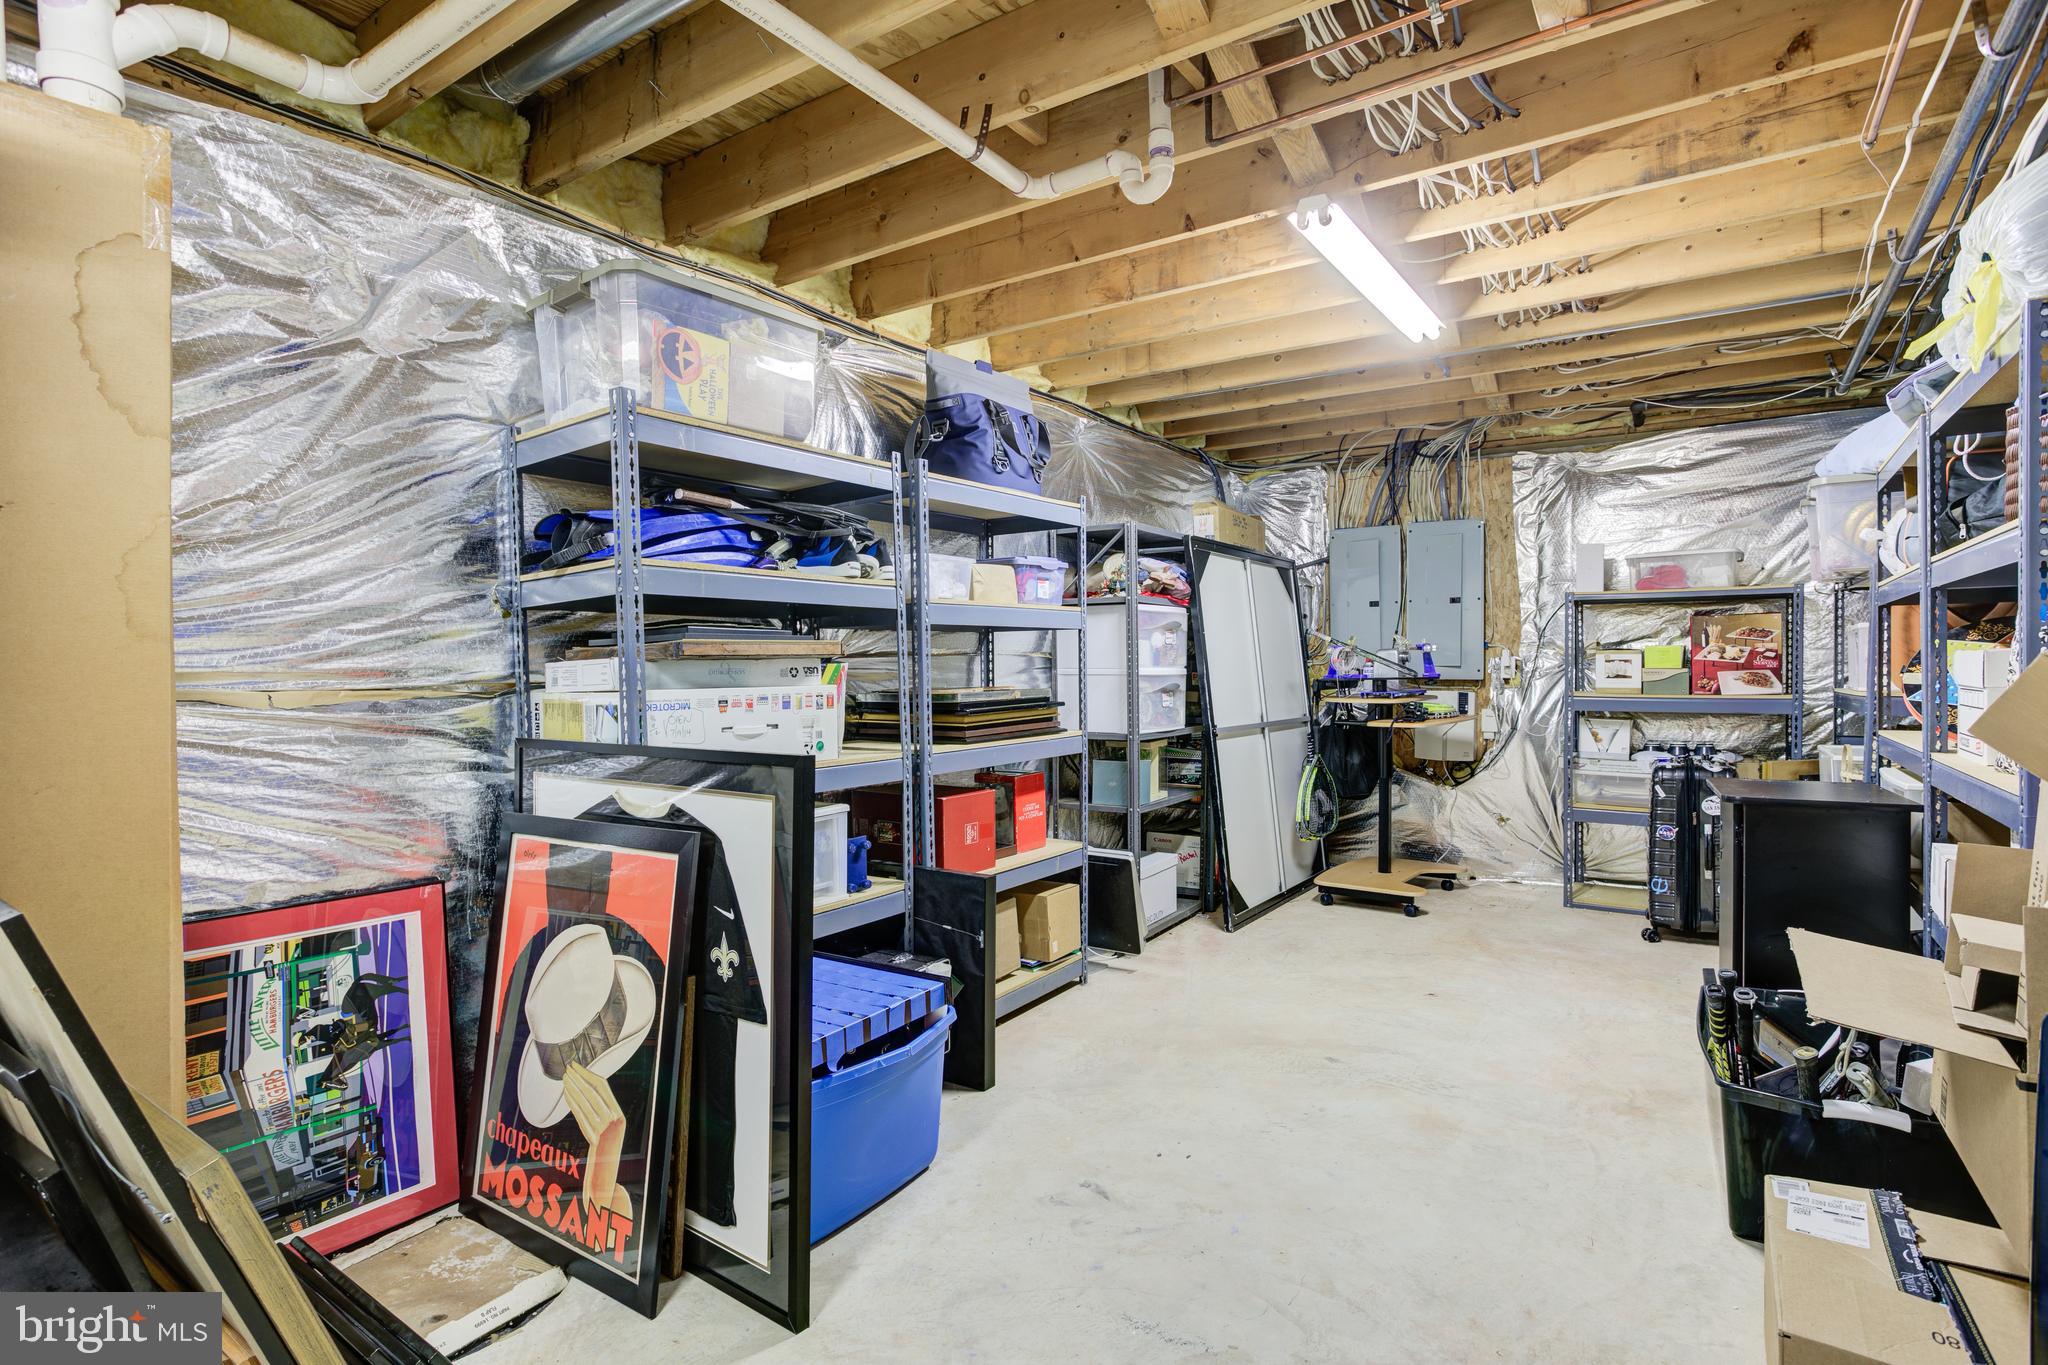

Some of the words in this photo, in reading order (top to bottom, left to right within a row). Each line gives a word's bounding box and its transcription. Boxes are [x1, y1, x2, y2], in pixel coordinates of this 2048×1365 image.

[698, 379, 709, 401] PLAY
[708, 368, 717, 417] HALLOWEEN
[803, 666, 819, 675] USA
[646, 702, 691, 712] MICROTEK
[268, 988, 278, 1034] HAMBURGERS
[249, 1020, 280, 1051] LITTLE
[487, 1112, 580, 1180] chapeaux
[481, 1152, 634, 1264] MOSSANT
[485, 1305, 497, 1316] FLAP
